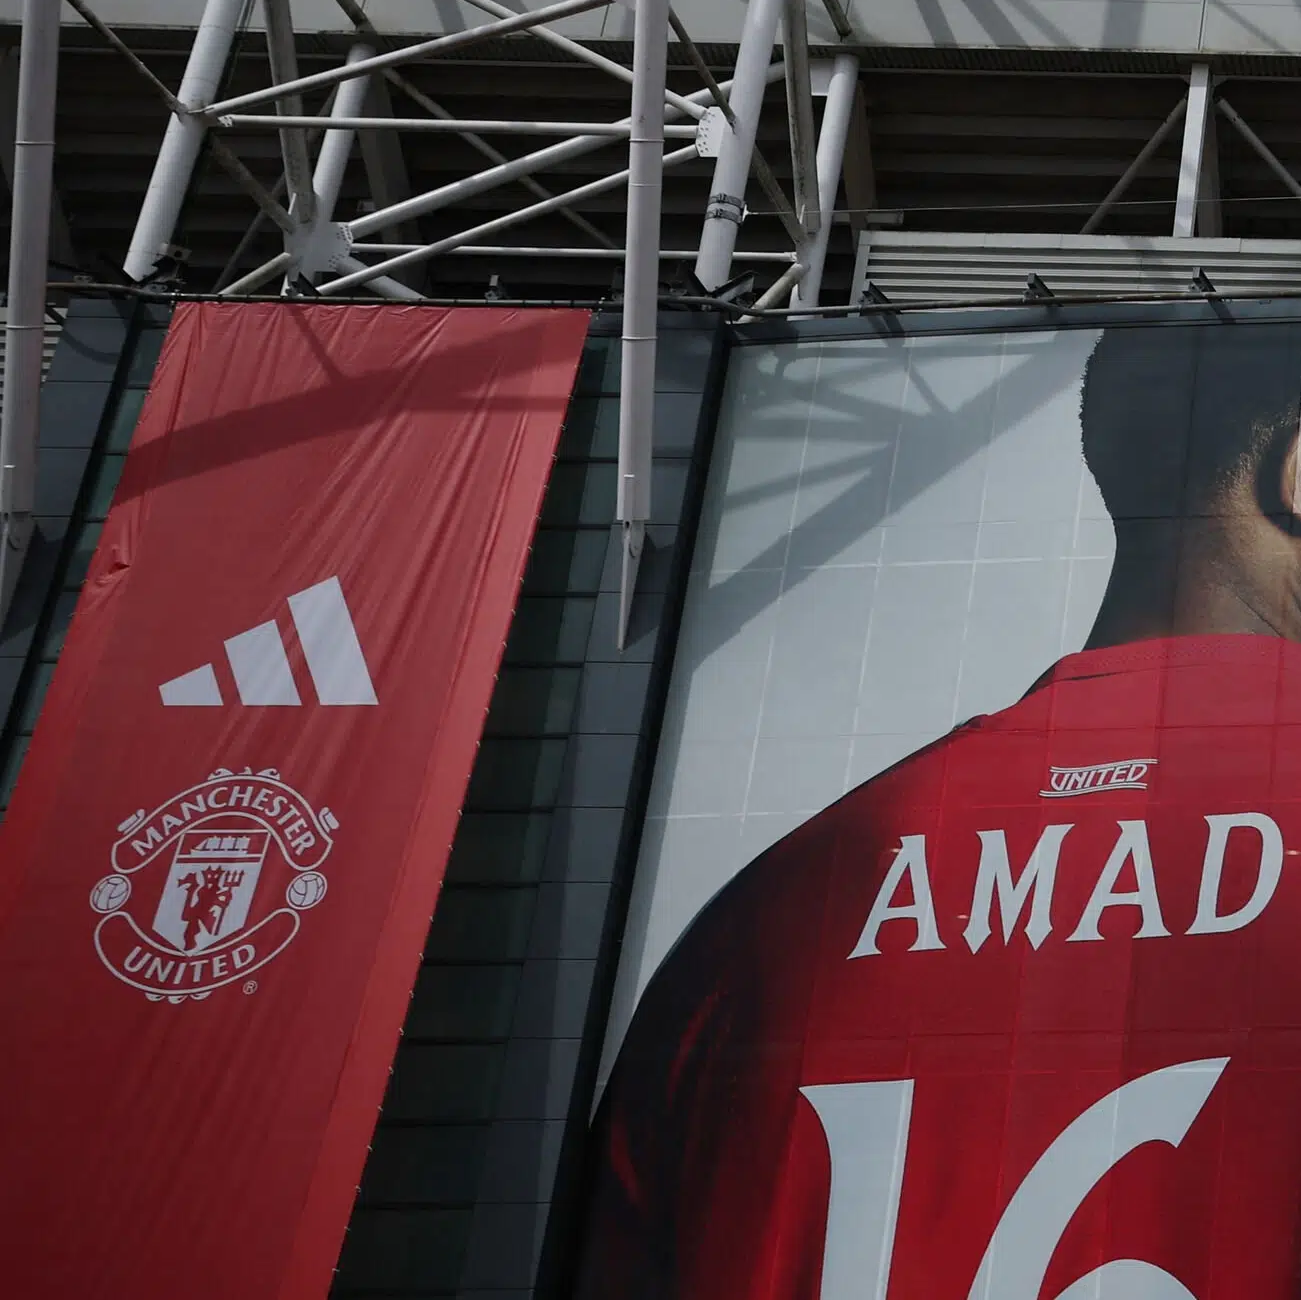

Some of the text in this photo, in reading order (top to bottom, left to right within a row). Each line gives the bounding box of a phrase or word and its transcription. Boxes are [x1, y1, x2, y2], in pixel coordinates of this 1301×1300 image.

[1050, 763, 1148, 791] UNITED
[131, 786, 316, 856] MANCHESTER
[847, 812, 1285, 960] AMAD
[124, 944, 257, 985] UNITED
